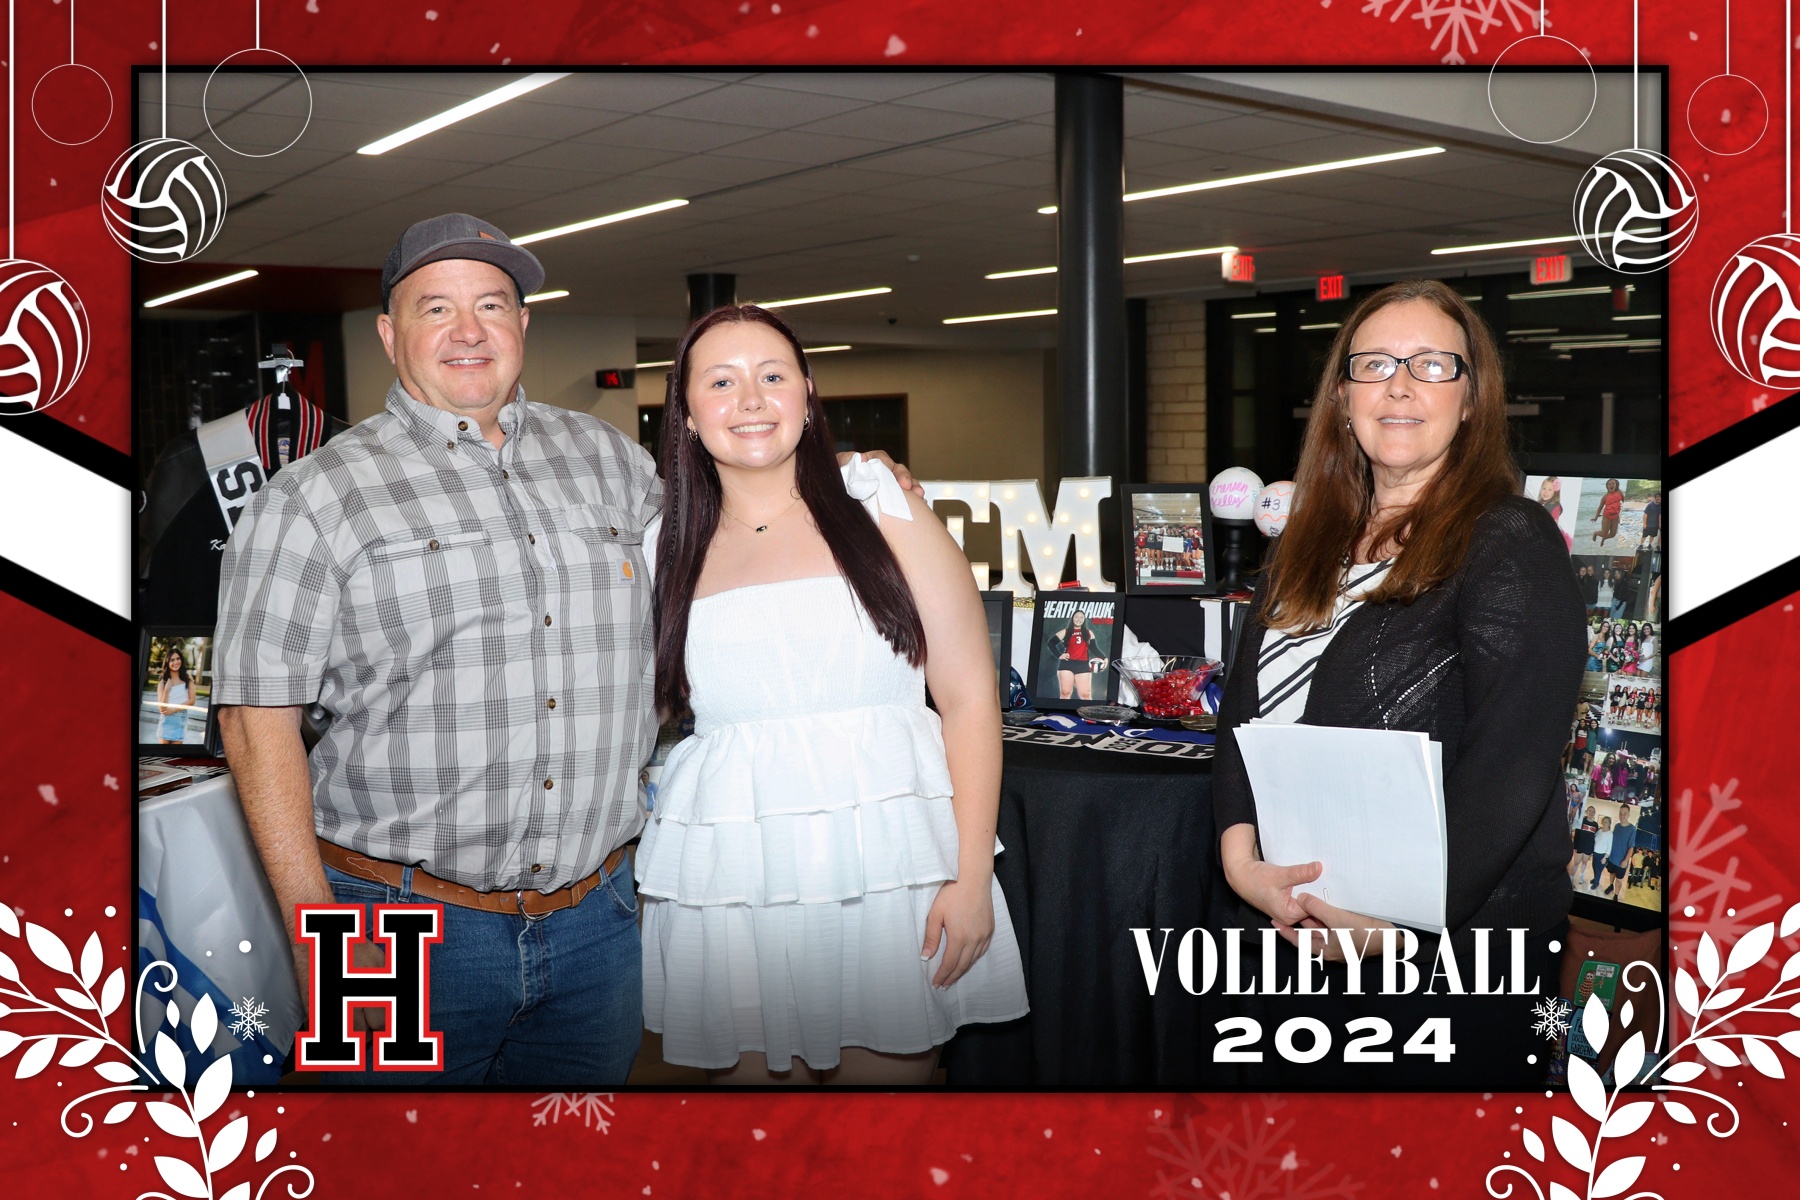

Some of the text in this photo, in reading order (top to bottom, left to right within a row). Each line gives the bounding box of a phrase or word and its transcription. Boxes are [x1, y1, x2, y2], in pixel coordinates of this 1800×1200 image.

[1536, 256, 1567, 282] EXIT
[1320, 275, 1344, 299] EXIT
[1261, 497, 1281, 511] #3
